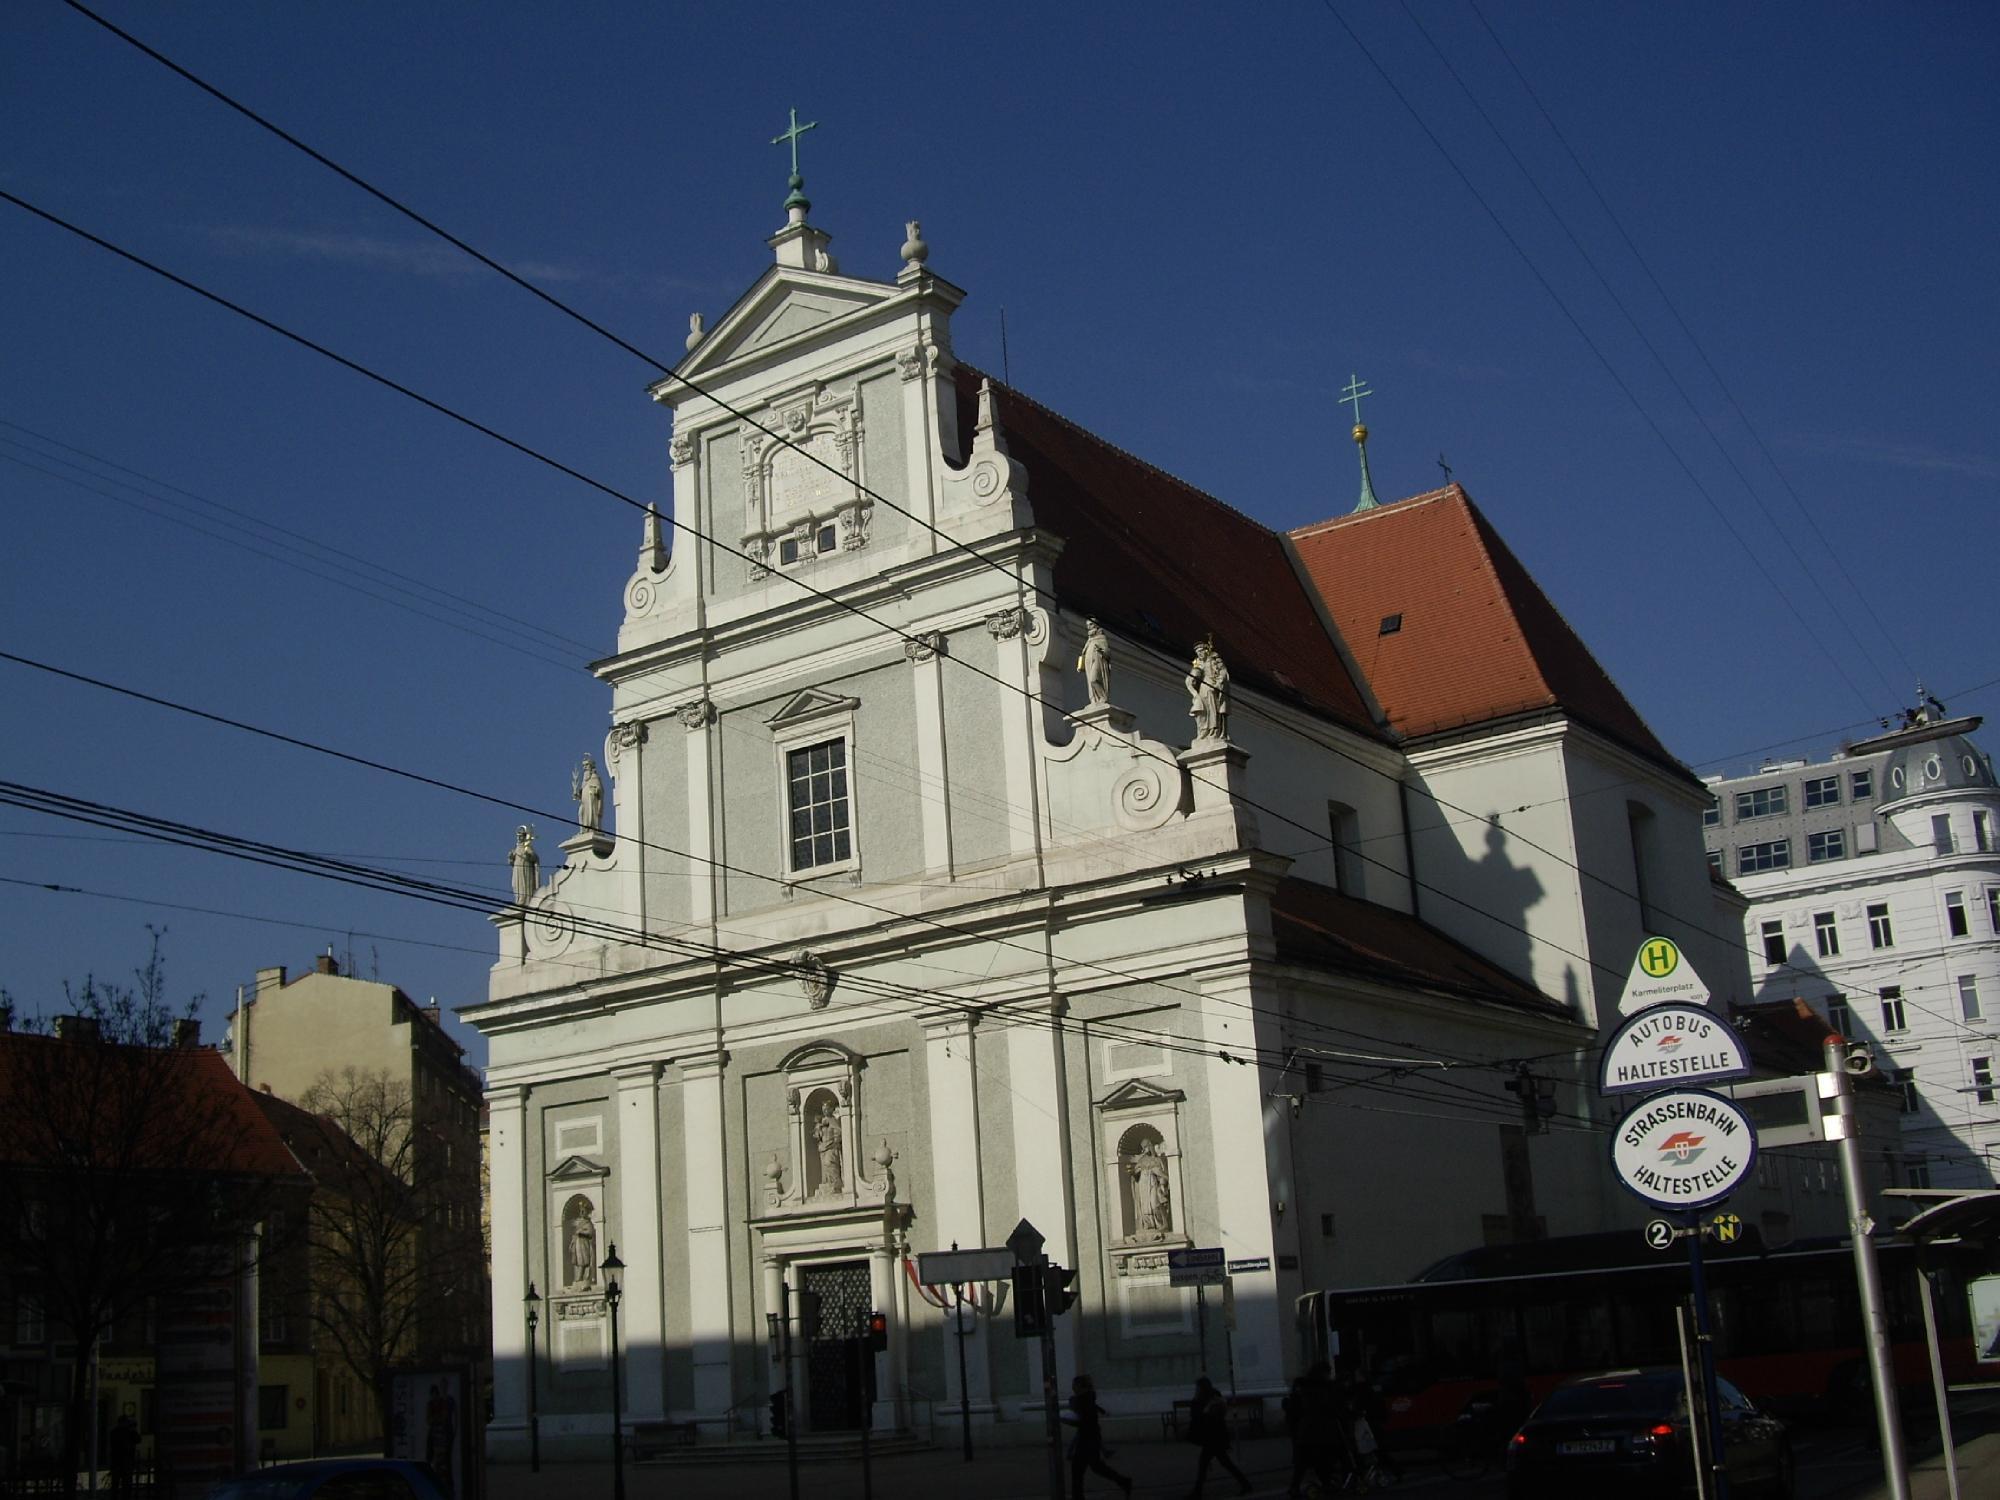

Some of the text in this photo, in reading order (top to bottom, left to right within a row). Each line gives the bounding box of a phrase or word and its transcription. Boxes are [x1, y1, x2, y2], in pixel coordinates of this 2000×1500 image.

[1648, 945, 1669, 971] H
[1632, 983, 1694, 997] Karmeliterplatz
[1630, 1014, 1711, 1047] AUTOBUS
[1617, 1052, 1730, 1081] HALTESTELLE
[1625, 1102, 1738, 1147] STRASSENBAHN
[1633, 1155, 1737, 1195] HALTESTELLE
[1652, 1224, 1668, 1244] 2
[1719, 1223, 1735, 1242] N
